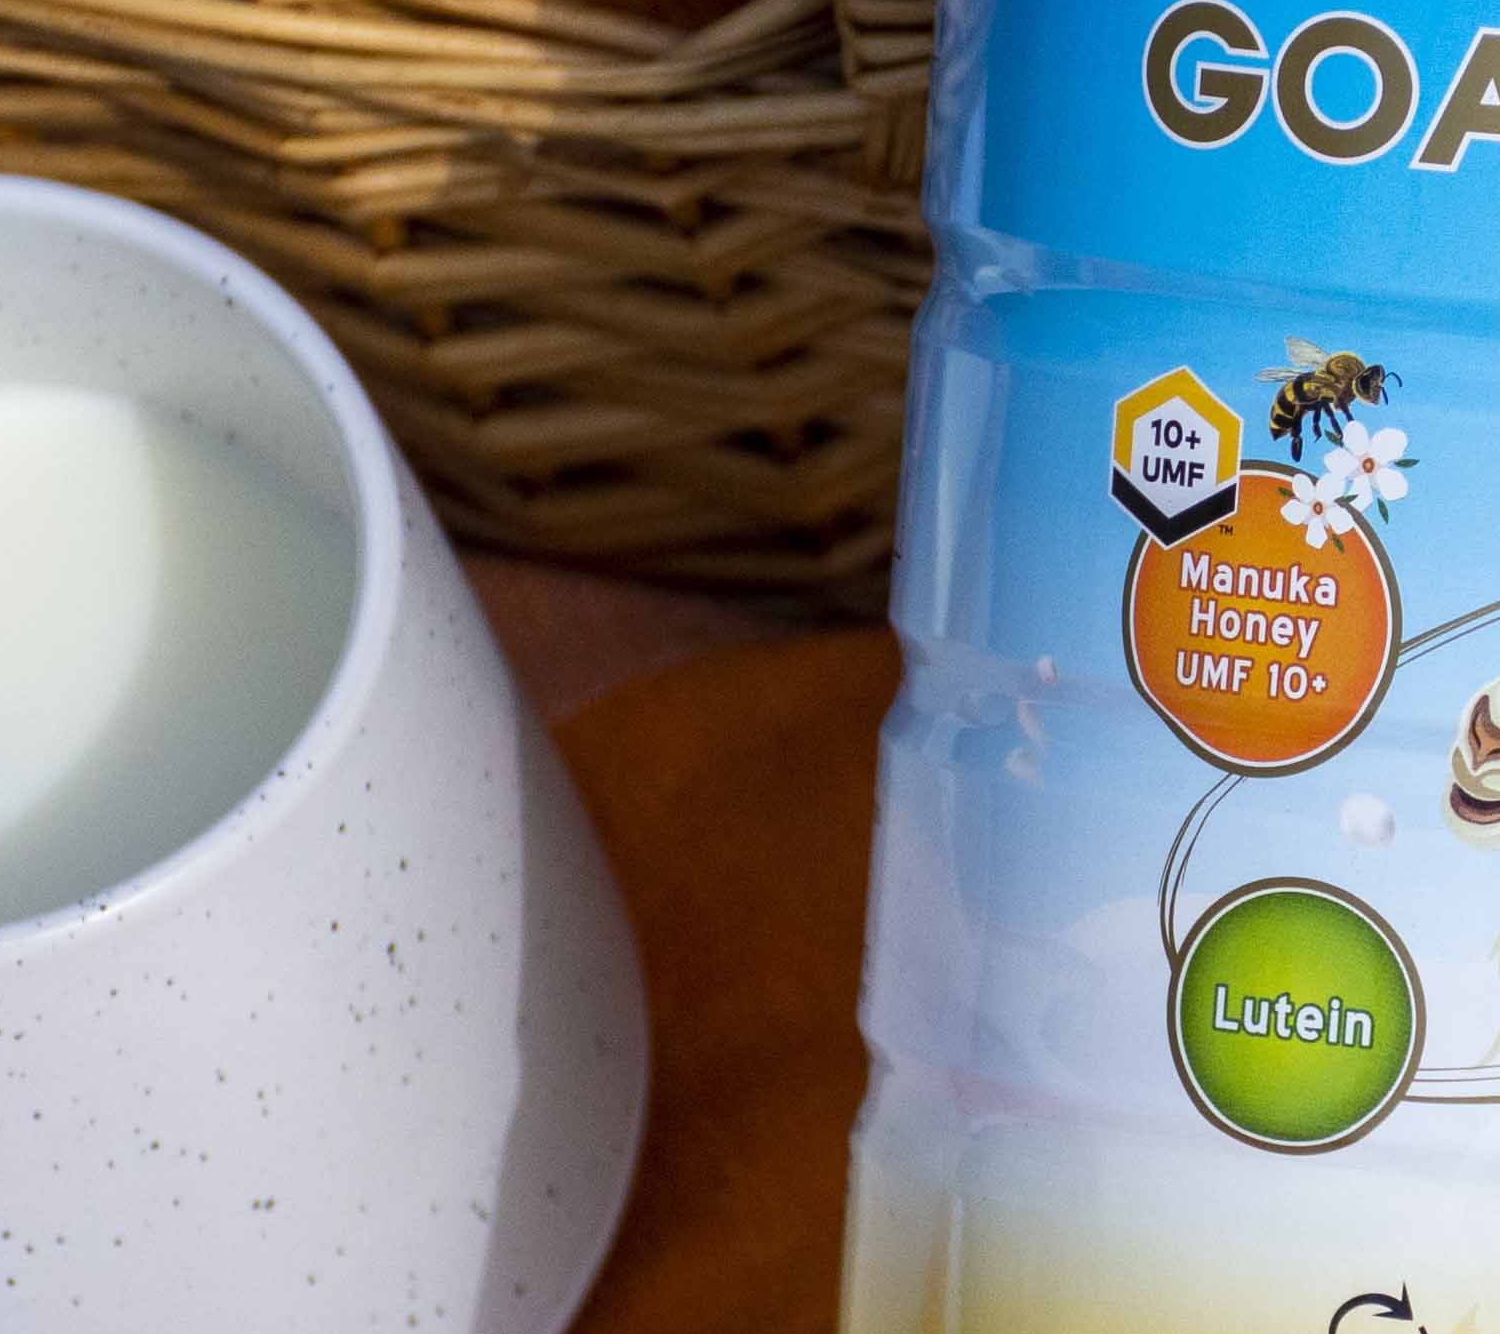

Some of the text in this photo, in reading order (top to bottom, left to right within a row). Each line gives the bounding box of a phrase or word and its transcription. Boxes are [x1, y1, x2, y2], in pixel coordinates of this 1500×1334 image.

[1151, 418, 1201, 451] 10+
[1143, 455, 1205, 488] UMF
[1180, 551, 1338, 608] Manuka
[1189, 598, 1321, 660] Honey
[1175, 650, 1329, 700] UMF 10+
[1213, 984, 1374, 1048] Lutein
